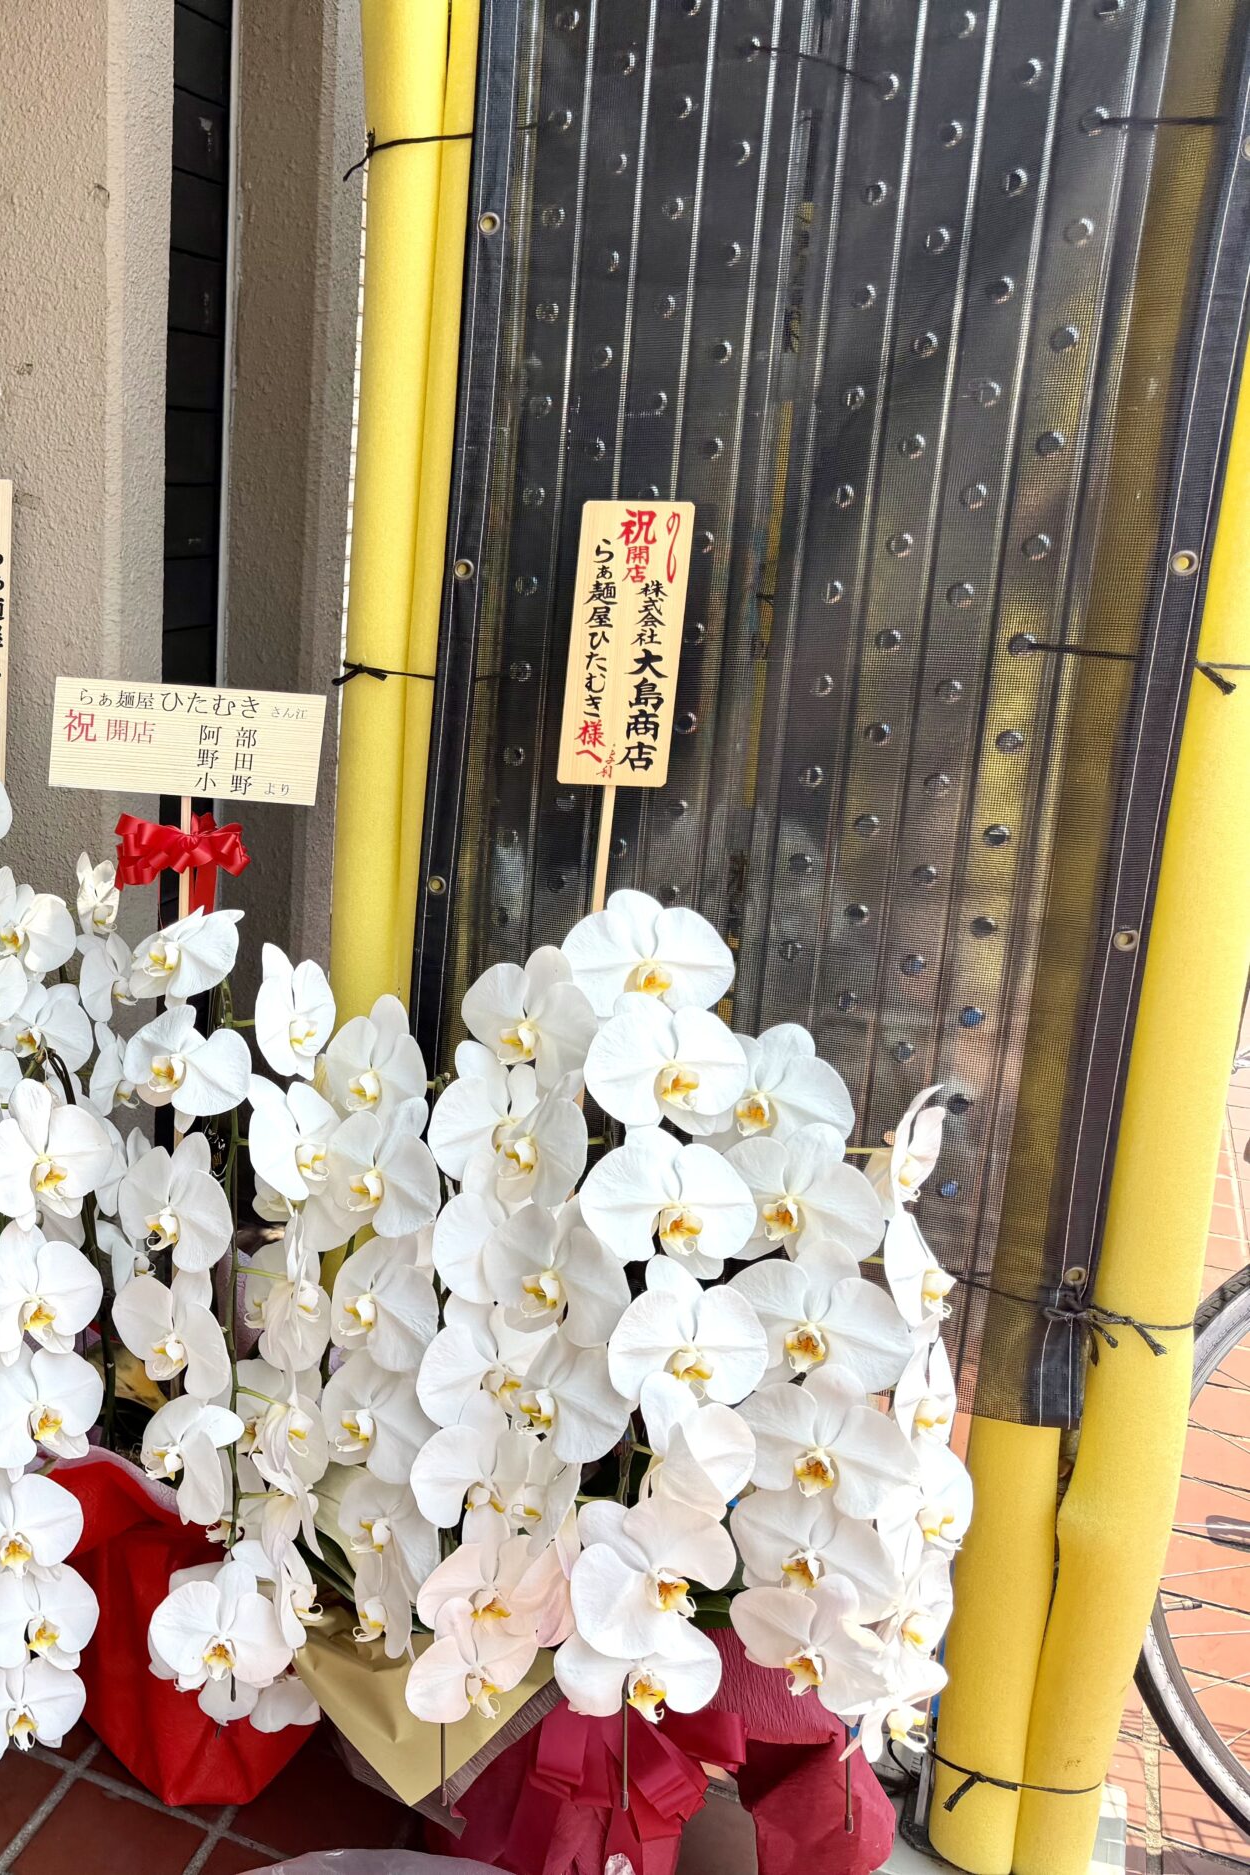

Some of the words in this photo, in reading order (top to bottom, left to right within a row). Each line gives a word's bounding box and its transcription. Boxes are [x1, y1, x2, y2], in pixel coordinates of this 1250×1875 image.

[63, 708, 97, 743] 祝
[106, 718, 156, 744] 開店
[199, 724, 257, 749] 阿部
[196, 749, 253, 771] 野田
[194, 772, 252, 796] 小野
[264, 782, 290, 796] より
